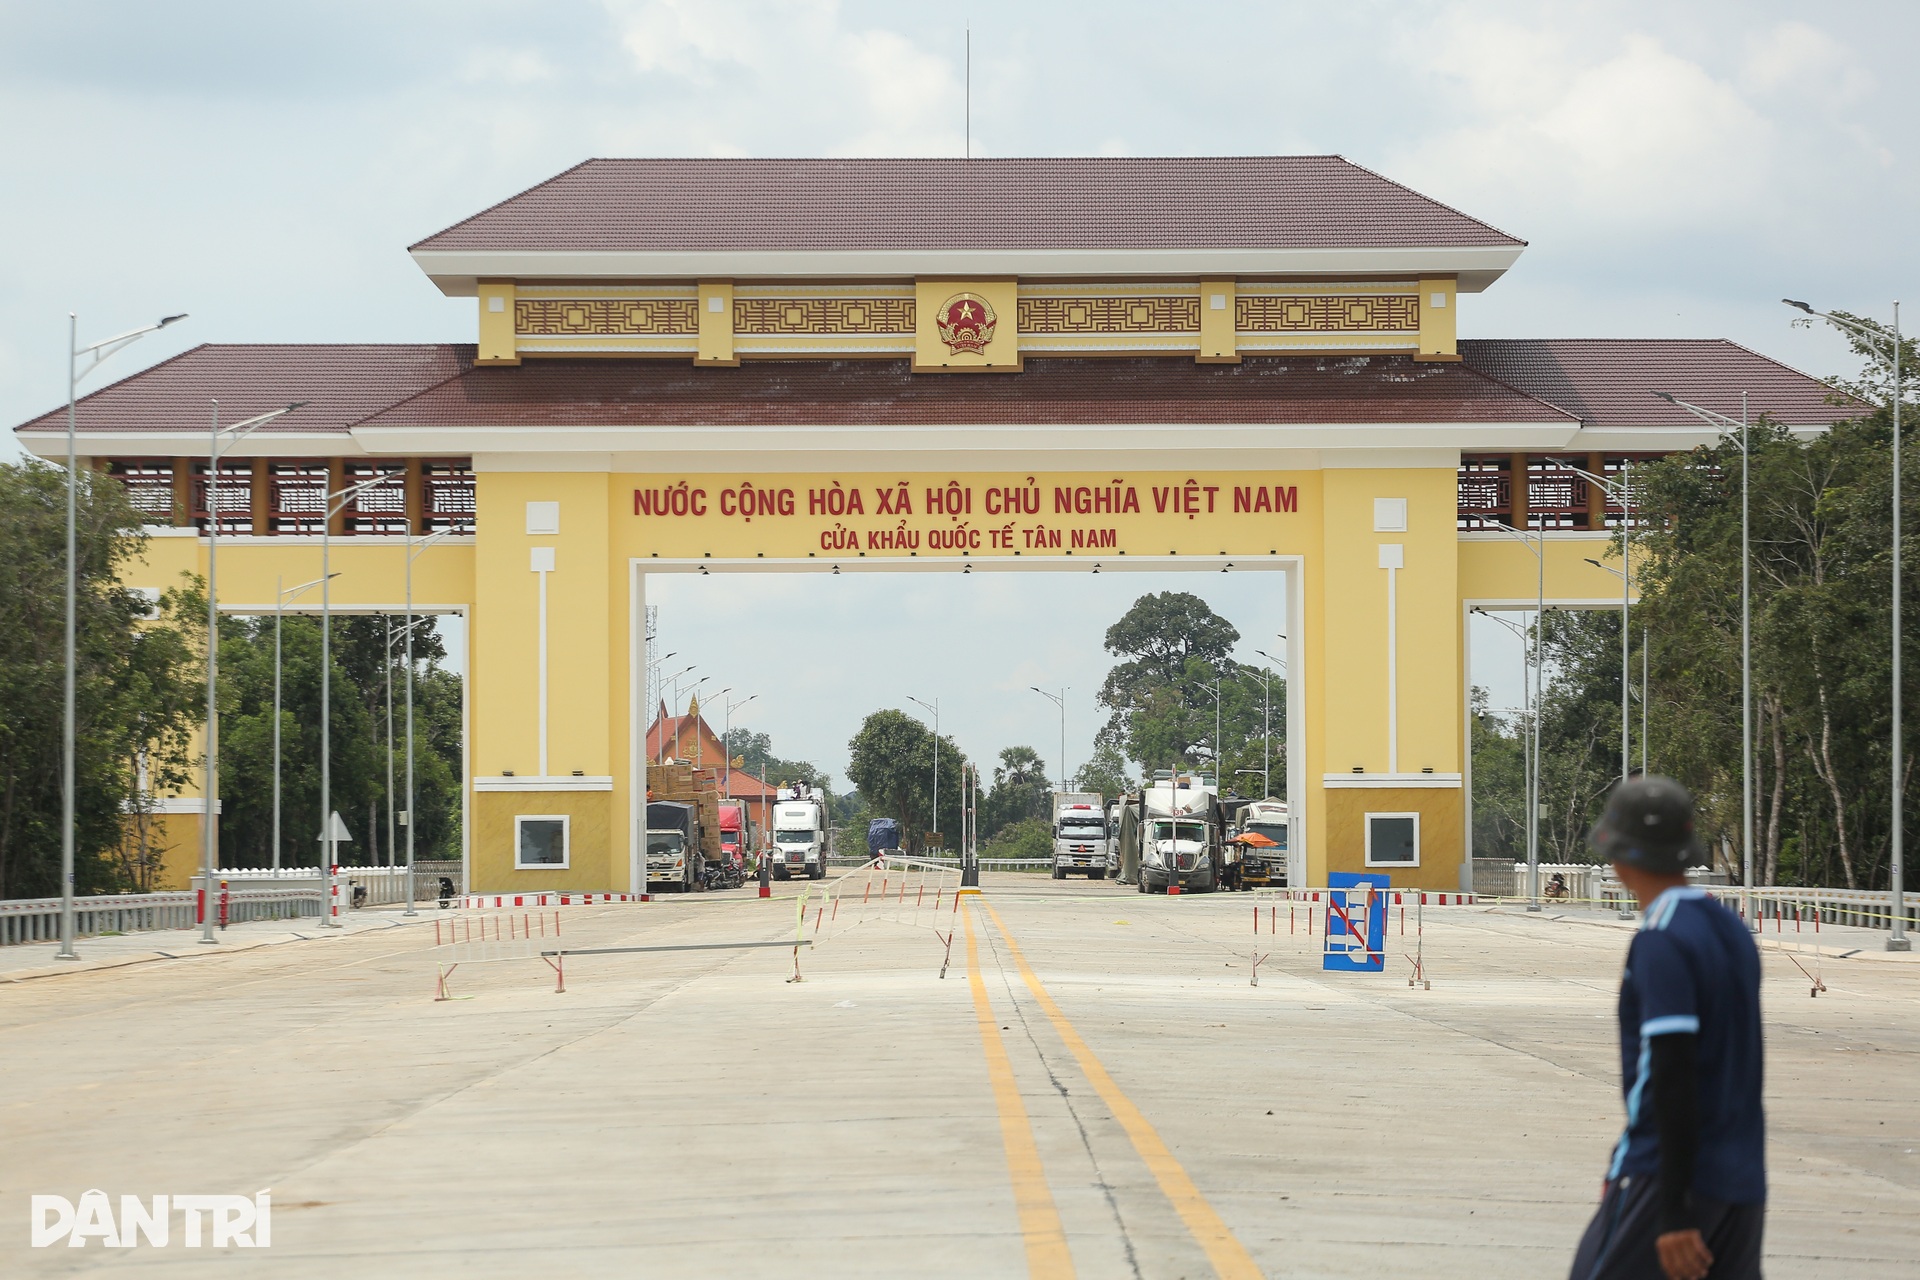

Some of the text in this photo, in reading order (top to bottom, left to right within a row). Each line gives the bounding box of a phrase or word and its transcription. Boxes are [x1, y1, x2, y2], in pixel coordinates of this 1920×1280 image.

[634, 476, 1298, 523] NƯỚC CỘNG HÒA XÃ HỘI CHỦ NGHĨA VIỆT NAM
[820, 519, 1117, 550] CỬA KHẨU QUỐC TẾ TÂN NAM
